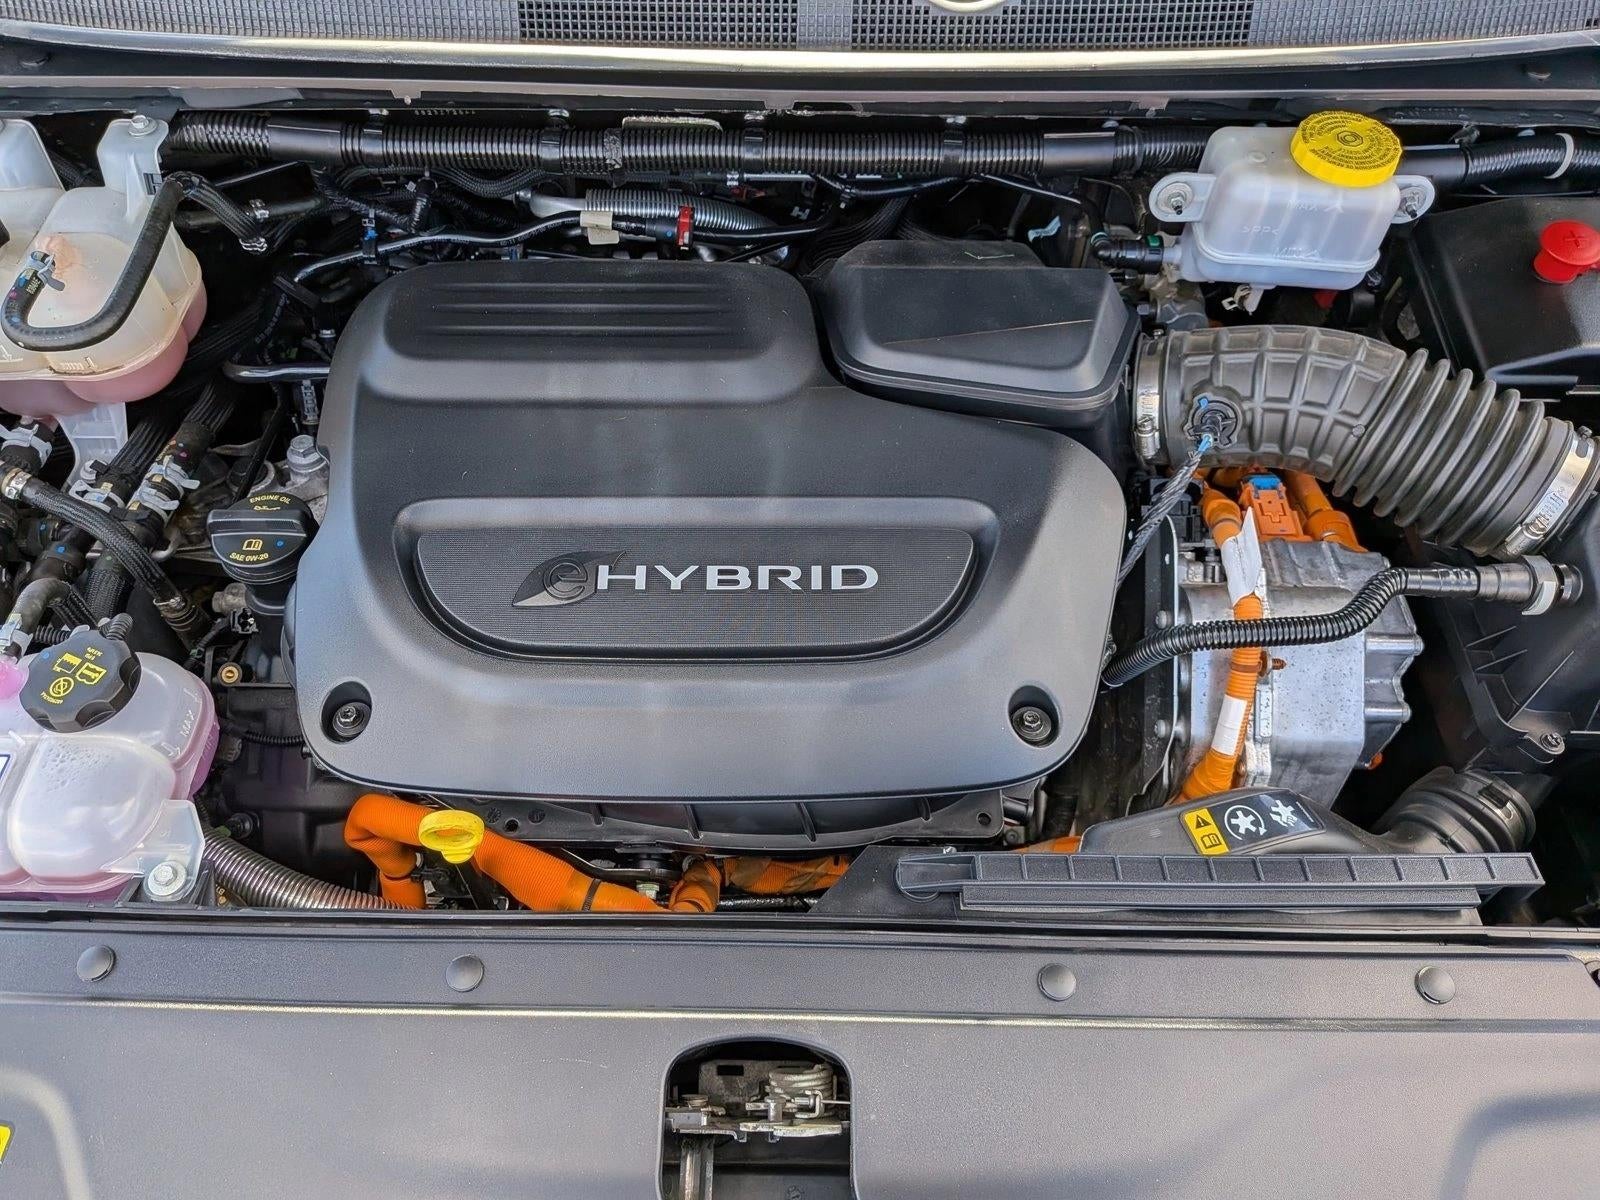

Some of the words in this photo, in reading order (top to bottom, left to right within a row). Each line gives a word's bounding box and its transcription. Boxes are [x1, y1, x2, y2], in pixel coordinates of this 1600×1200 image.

[249, 495, 279, 503] ENGINE
[280, 496, 291, 504] OIL
[229, 552, 244, 561] SAE
[245, 553, 269, 561] 0W-20
